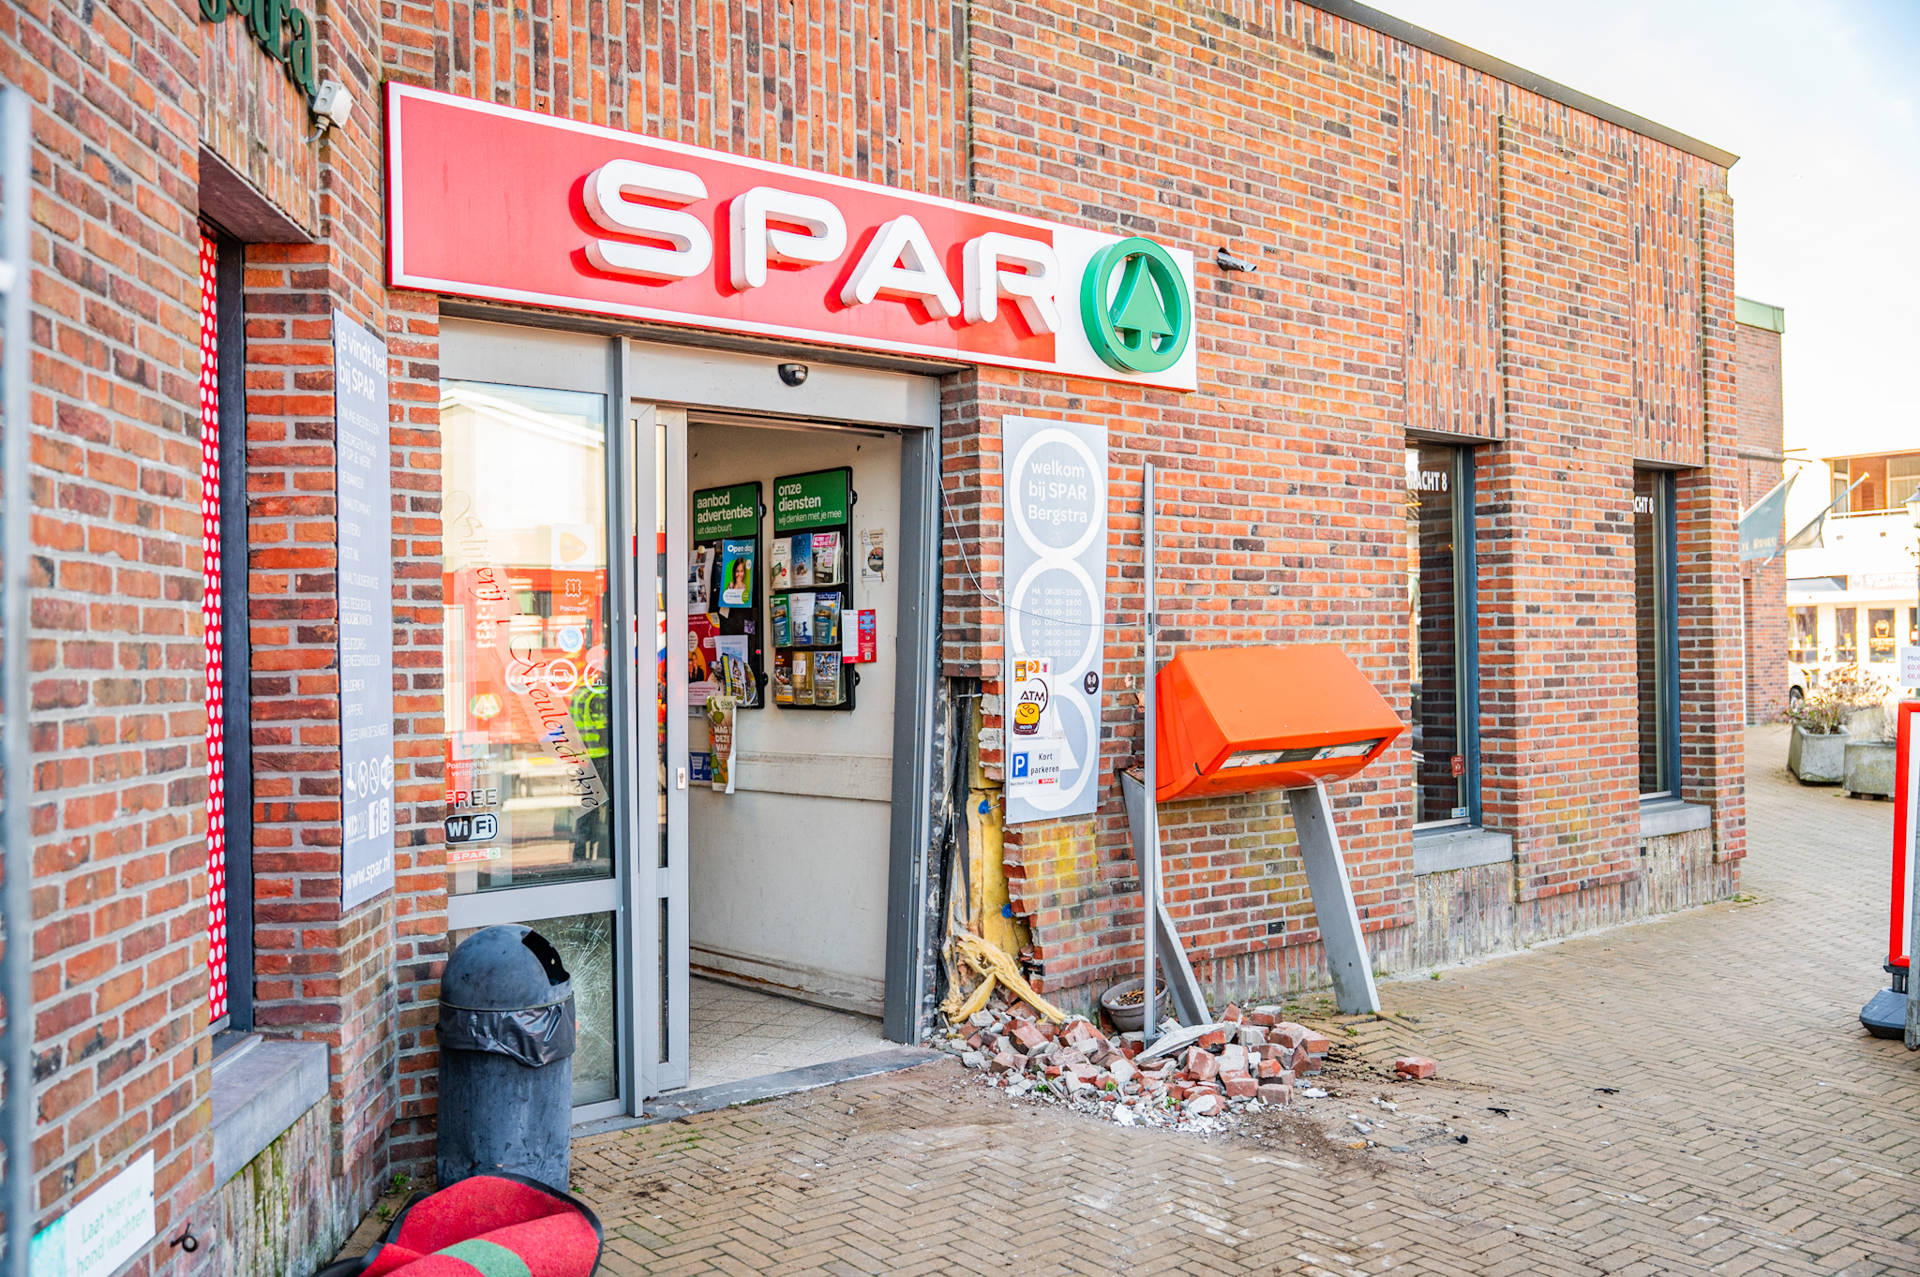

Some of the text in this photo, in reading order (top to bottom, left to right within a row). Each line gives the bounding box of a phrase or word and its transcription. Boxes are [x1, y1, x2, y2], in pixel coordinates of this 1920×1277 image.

[583, 160, 1061, 335] SPAR
[338, 324, 387, 378] je vindt het
[339, 356, 376, 403] bij SPAR
[1031, 460, 1085, 478] welkom
[778, 483, 801, 496] onze
[1028, 481, 1088, 501] bij SPAR
[1441, 471, 1448, 491] 8
[697, 491, 730, 508] aanbod
[778, 496, 821, 512] diensten
[1649, 496, 1655, 514] 8
[697, 504, 753, 523] advertenties
[1028, 504, 1088, 525] Bergstra
[1020, 690, 1045, 701] ATM
[1030, 765, 1059, 776] parkeren
[445, 788, 498, 808] FREE
[344, 849, 391, 892] www.spar.nl
[81, 1212, 105, 1245] Laat
[77, 1239, 105, 1274] hond
